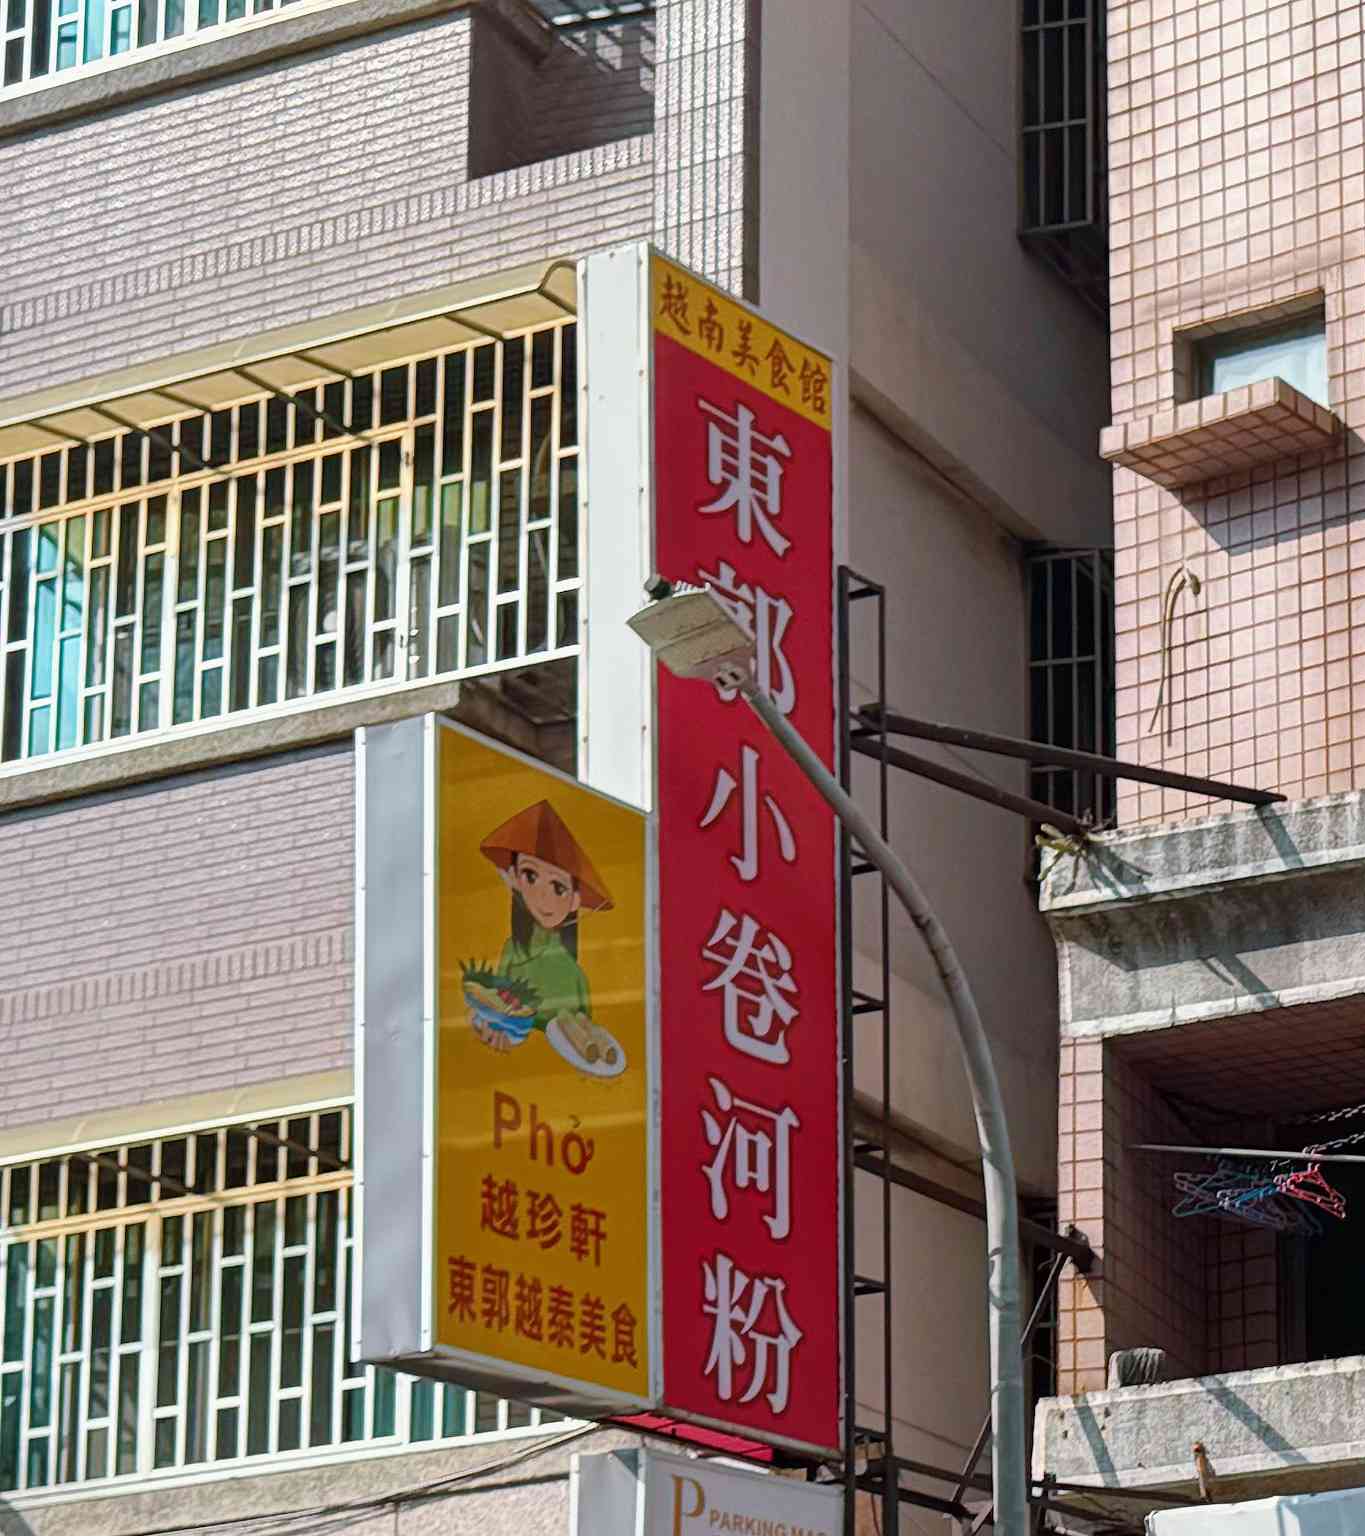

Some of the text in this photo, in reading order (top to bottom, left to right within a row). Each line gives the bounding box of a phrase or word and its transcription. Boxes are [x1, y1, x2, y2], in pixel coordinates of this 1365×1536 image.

[658, 274, 829, 416] 越南美食館
[480, 1173, 607, 1268] 越珍軒
[448, 1254, 638, 1369] 東郭越泰美食
